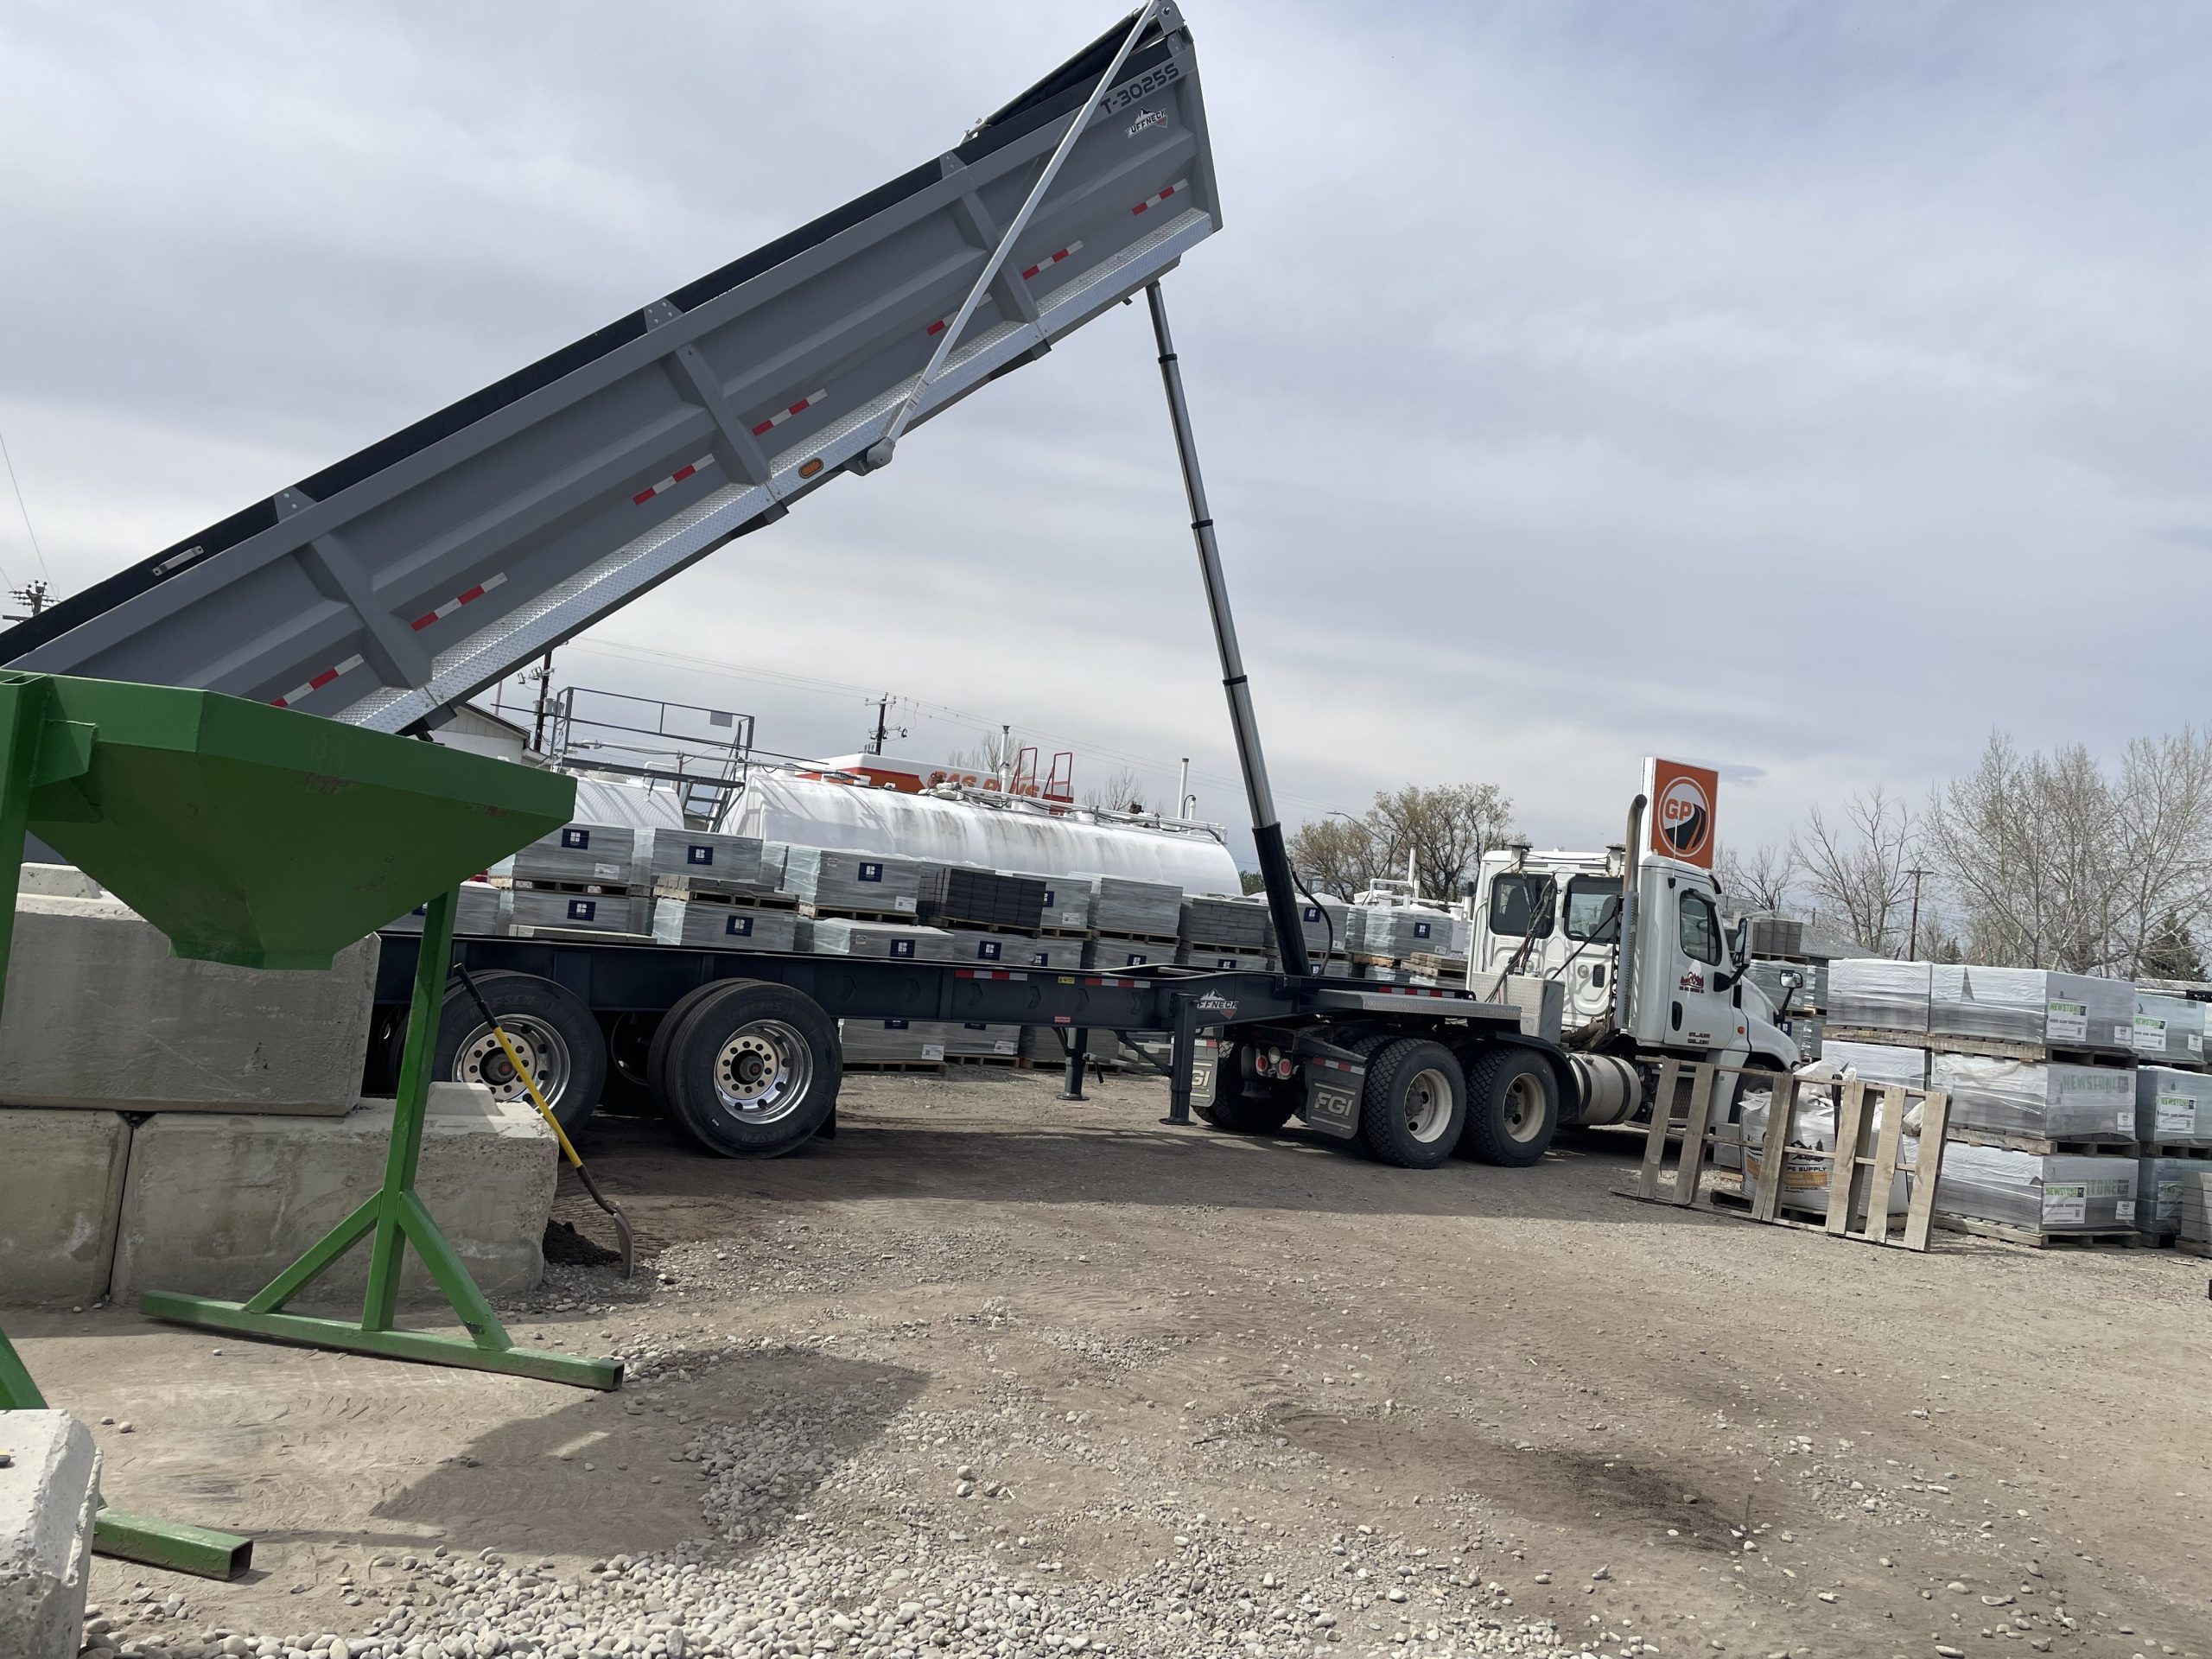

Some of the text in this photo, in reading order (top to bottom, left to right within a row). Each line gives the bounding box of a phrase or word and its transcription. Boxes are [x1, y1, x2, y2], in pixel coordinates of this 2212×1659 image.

[1665, 798, 1693, 821] GP
[1192, 1070, 1211, 1087] GI
[1314, 1091, 1353, 1116] FGI
